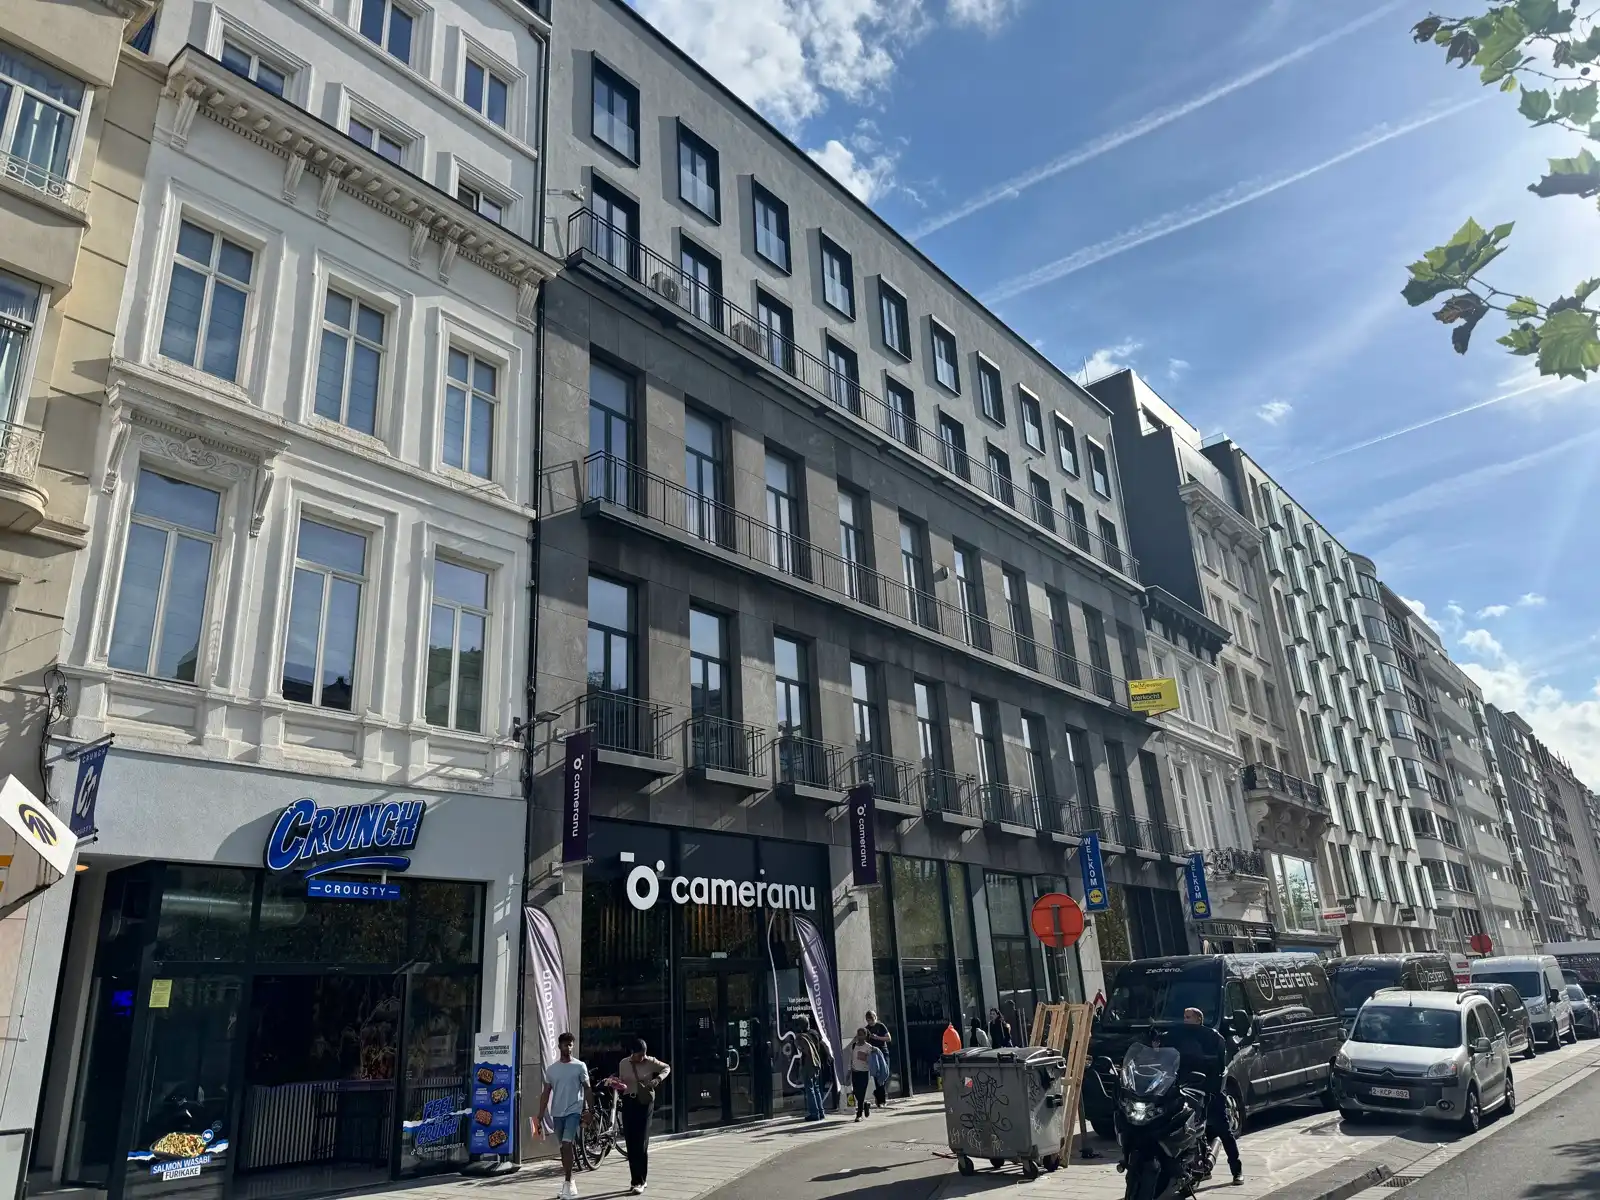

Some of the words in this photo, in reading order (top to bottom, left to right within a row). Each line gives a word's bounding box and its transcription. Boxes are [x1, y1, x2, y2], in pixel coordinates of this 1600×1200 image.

[82, 748, 106, 764] CRUNCH
[572, 773, 581, 837] cameranu
[267, 798, 424, 871] CRUNCH
[858, 818, 867, 867] cameranu
[1083, 837, 1098, 886] WELKOM
[324, 884, 386, 896] CROUSTY
[671, 868, 816, 911] cameranu
[543, 970, 557, 1059] cameranu
[152, 1161, 183, 1174] SALMON
[183, 1155, 210, 1167] WASABI
[165, 1166, 199, 1180] FURIKAKE
